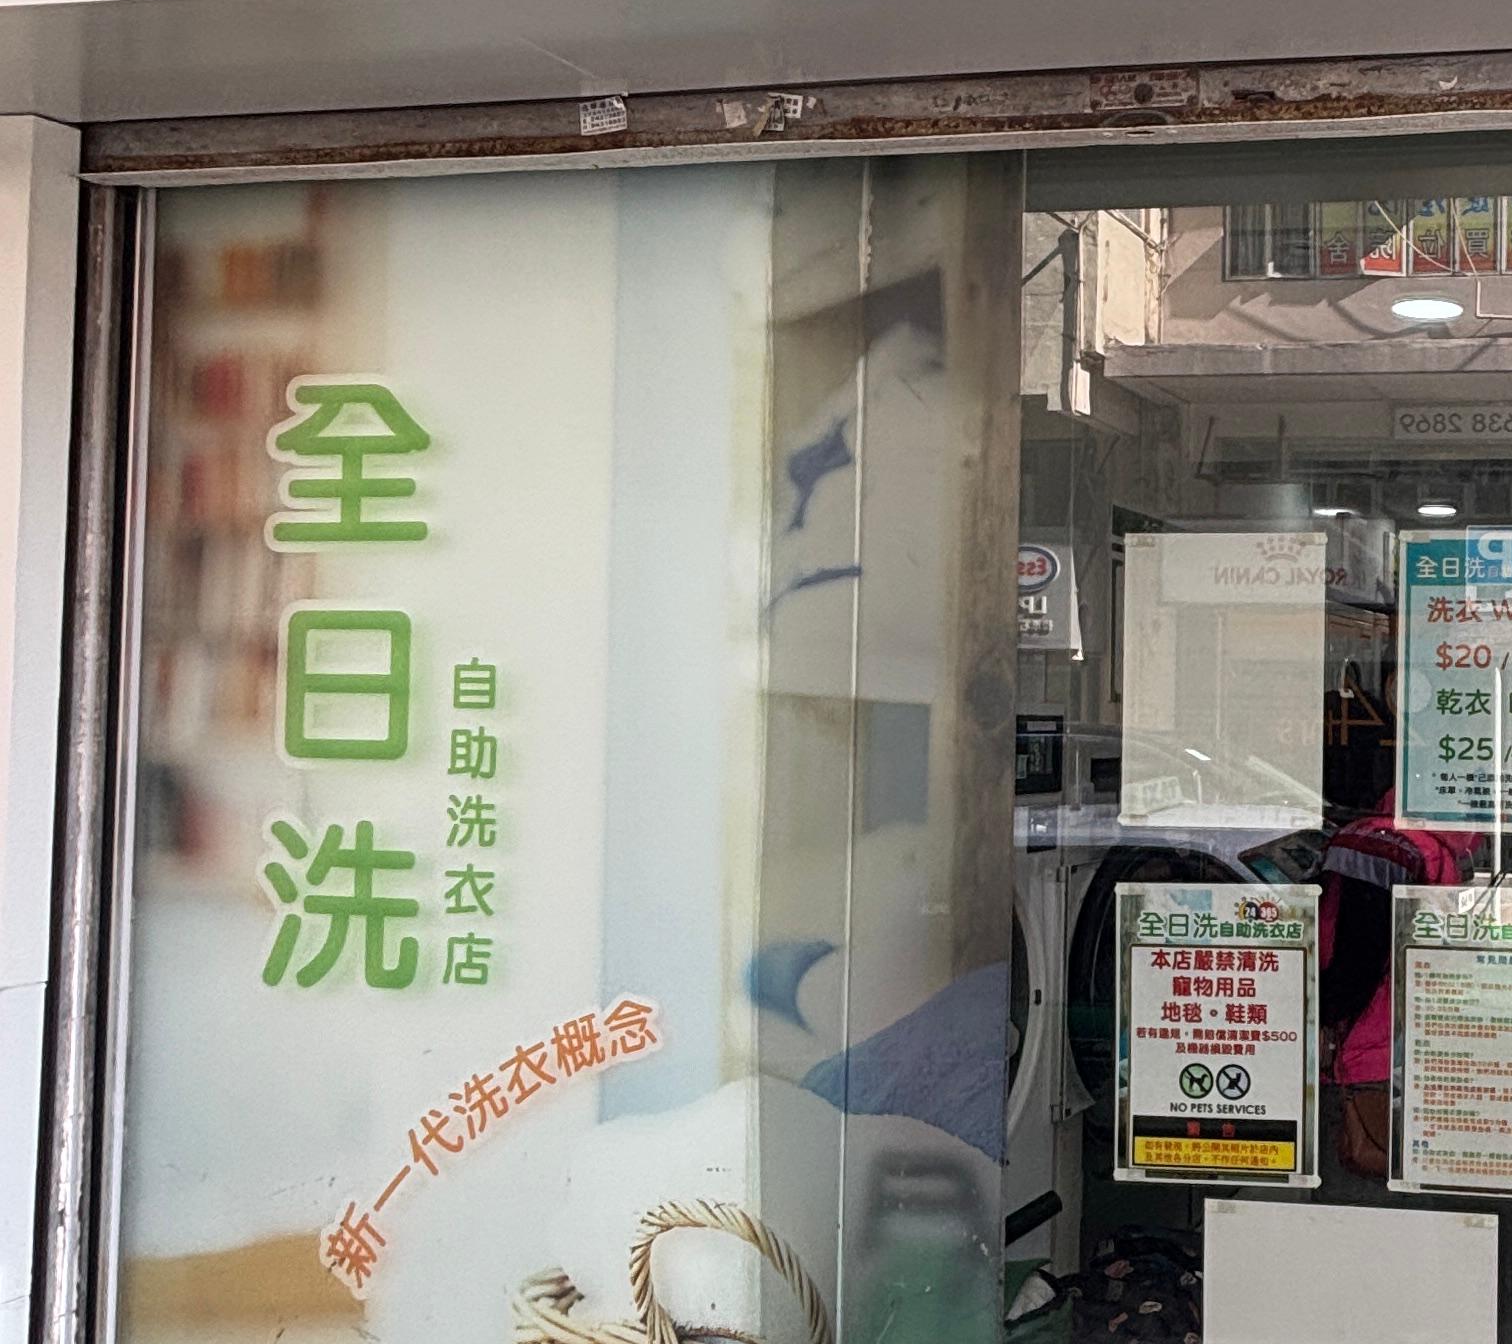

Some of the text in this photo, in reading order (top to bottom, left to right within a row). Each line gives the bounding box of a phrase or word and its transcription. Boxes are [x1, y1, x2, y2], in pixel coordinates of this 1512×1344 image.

[1426, 595, 1483, 623] 洗衣
[1435, 641, 1493, 671] $20
[262, 383, 432, 990] 全日洗
[1435, 687, 1492, 716] 乾衣
[1438, 733, 1494, 764] $25
[443, 656, 498, 986] 自助洗衣店
[1150, 949, 1280, 972] 本店嚴禁清洗
[1172, 976, 1257, 998] 寵物用品
[1169, 1102, 1267, 1116] NO PETS SERVICES
[325, 999, 658, 1290] 新一代洗衣概念
